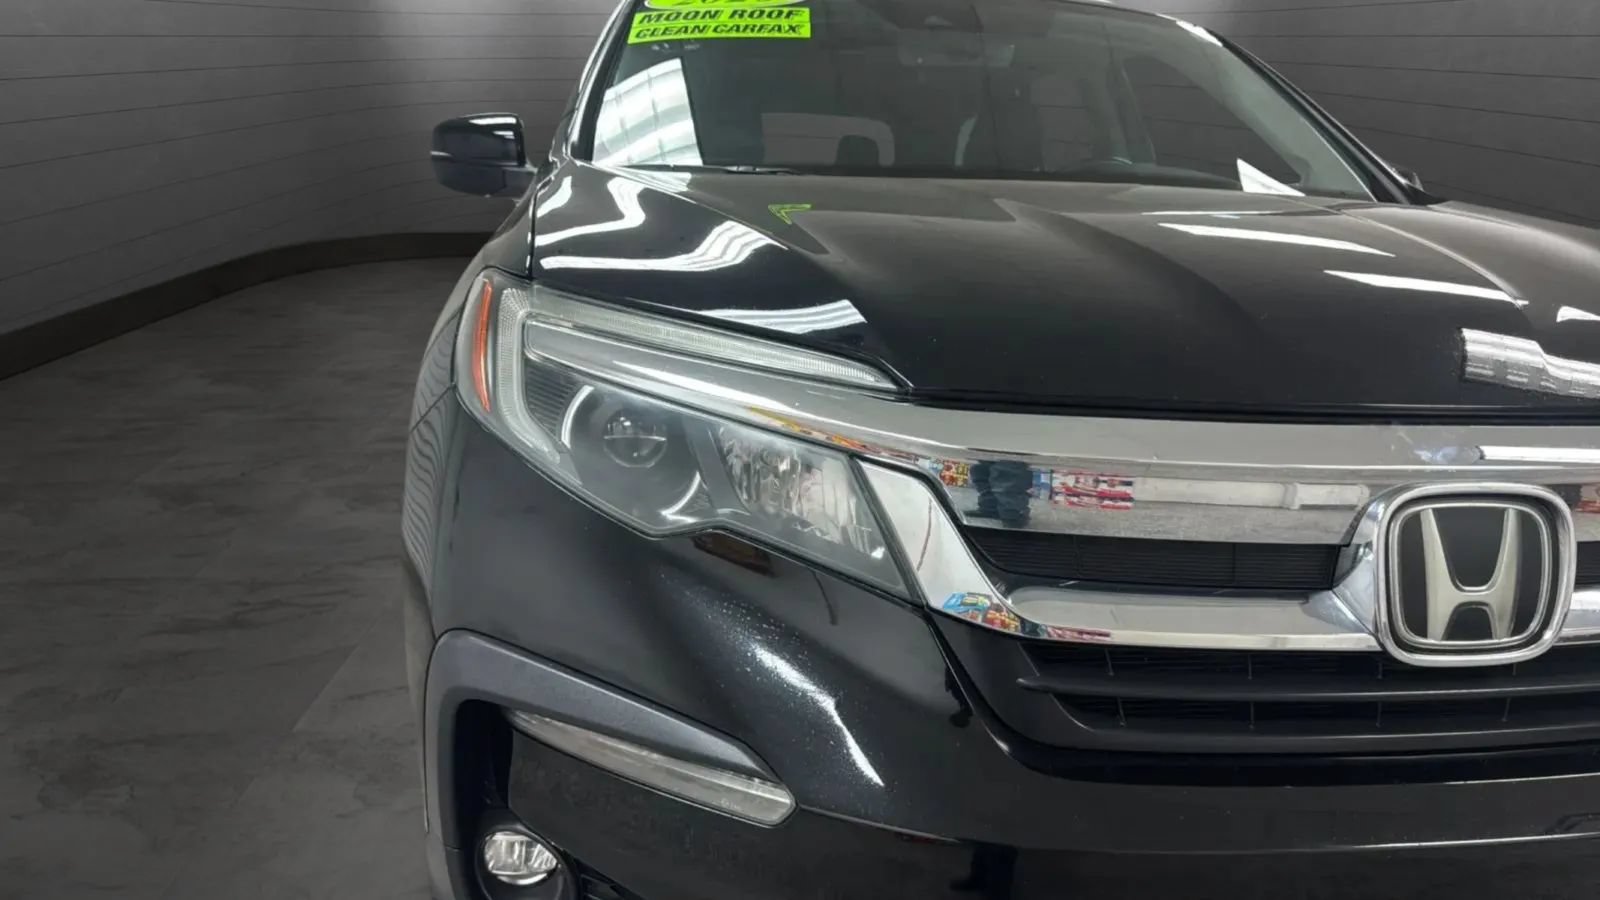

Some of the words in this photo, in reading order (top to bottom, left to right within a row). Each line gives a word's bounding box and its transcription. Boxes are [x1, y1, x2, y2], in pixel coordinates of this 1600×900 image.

[639, 10, 720, 24] MOON
[729, 8, 805, 20] ROOF
[635, 25, 708, 39] CLEAN
[712, 24, 803, 35] CARFAX
